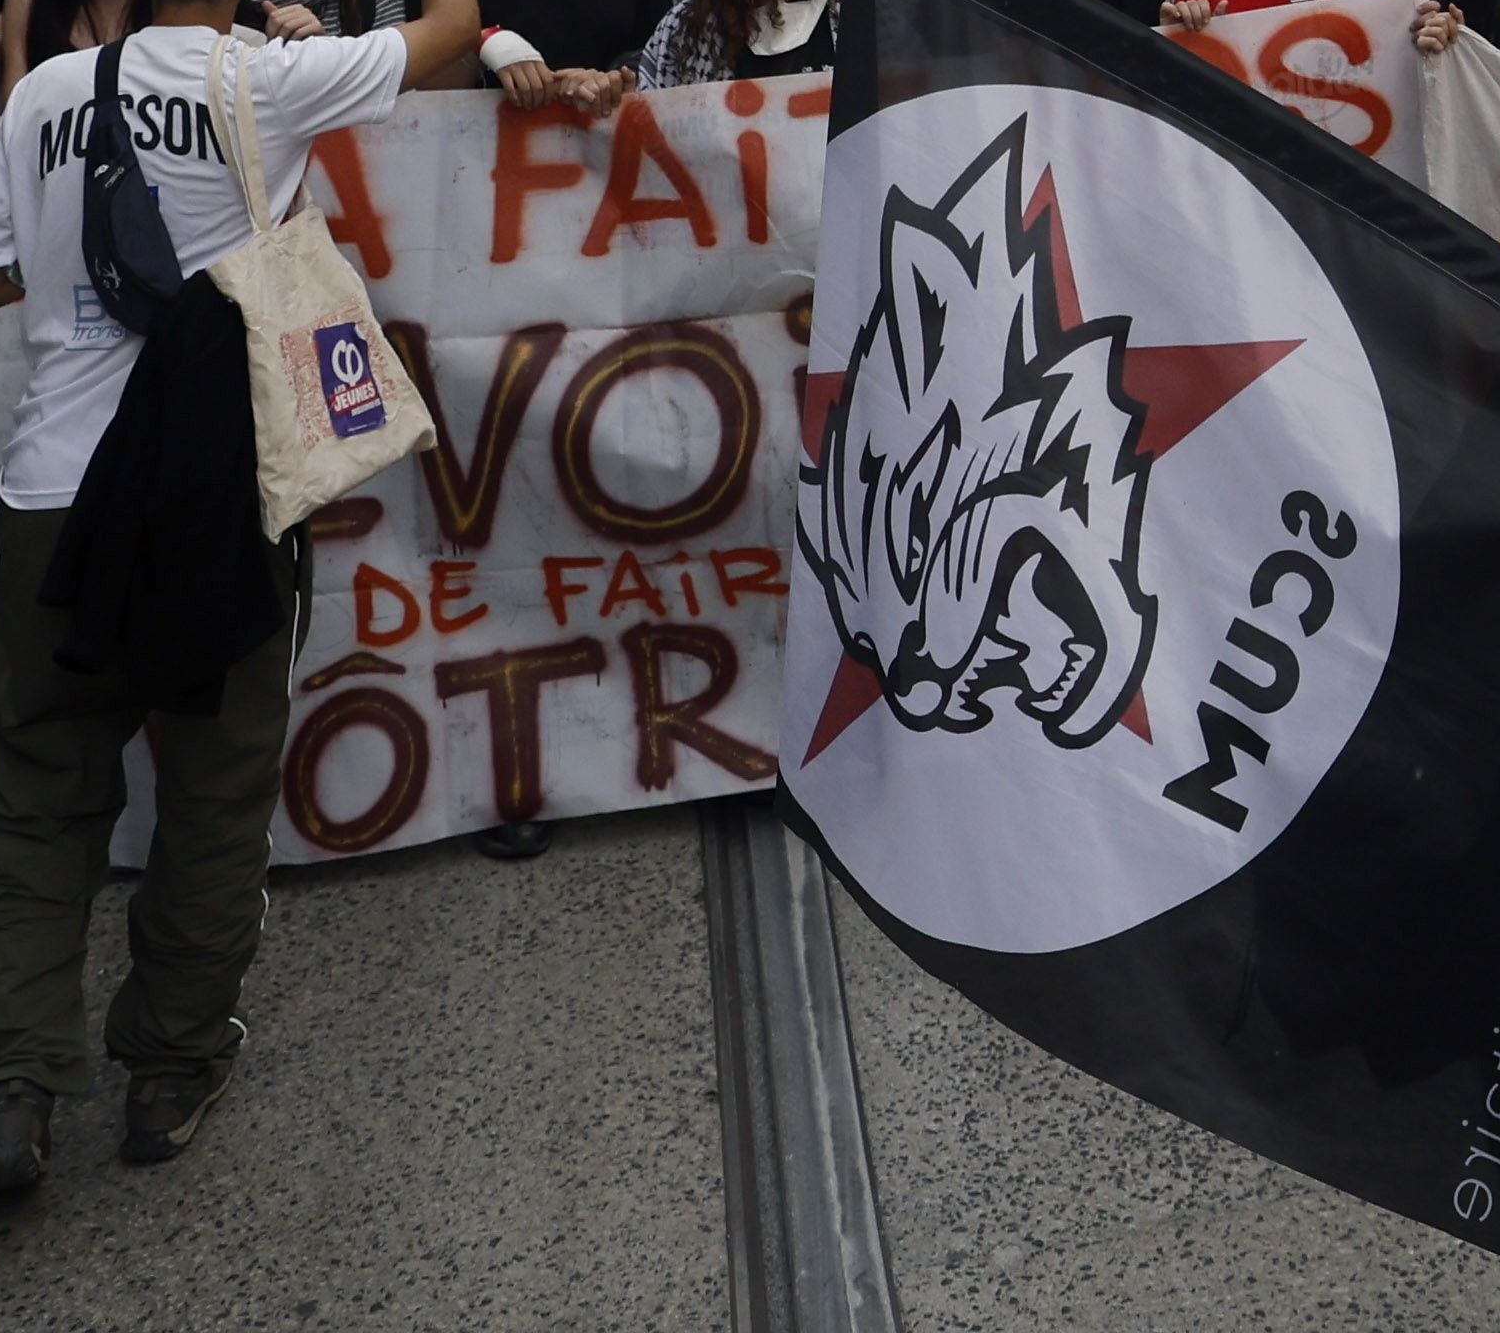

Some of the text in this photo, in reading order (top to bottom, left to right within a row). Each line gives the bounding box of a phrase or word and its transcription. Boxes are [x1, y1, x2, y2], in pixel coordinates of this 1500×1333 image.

[332, 381, 377, 413] JEUNES
[352, 560, 491, 648] DE
[282, 621, 785, 853] ÔTR
